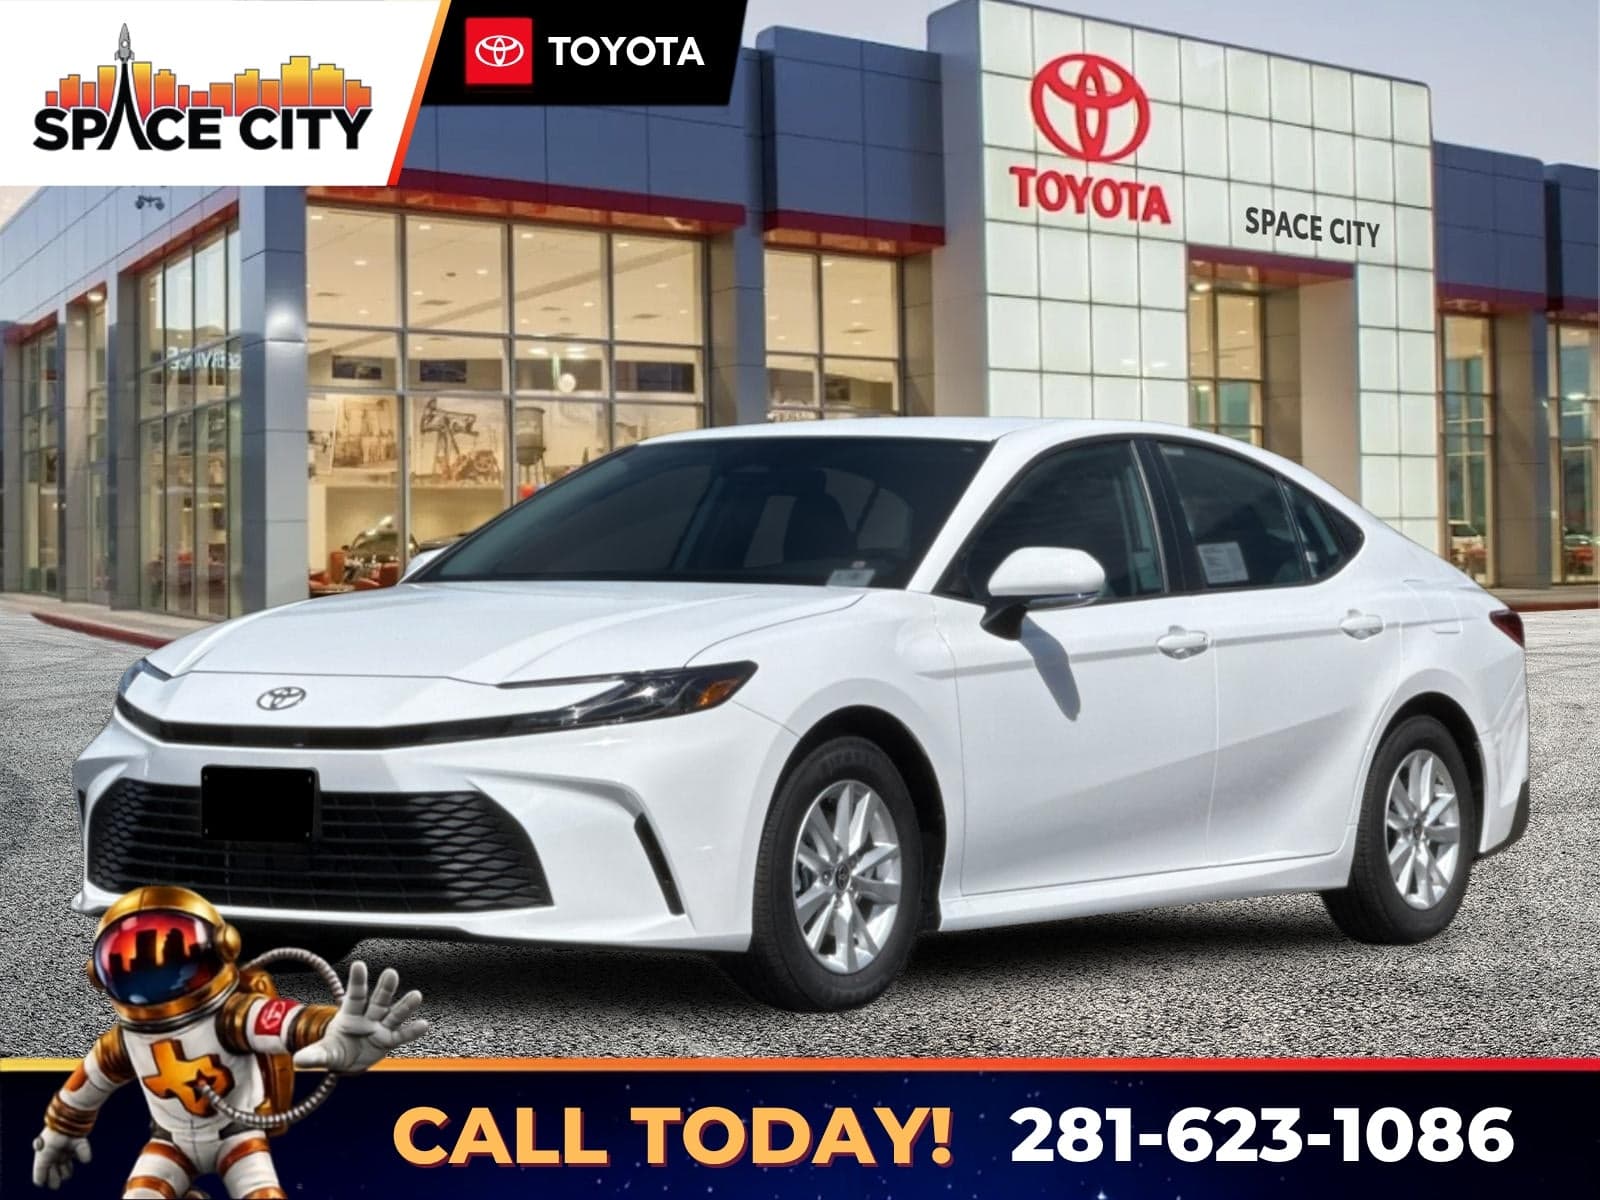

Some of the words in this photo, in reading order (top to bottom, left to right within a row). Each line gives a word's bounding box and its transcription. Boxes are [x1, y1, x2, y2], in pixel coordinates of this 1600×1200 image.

[1009, 166, 1171, 224] TOYOTA
[1245, 206, 1323, 242] SPACE
[1329, 218, 1381, 248] CITY
